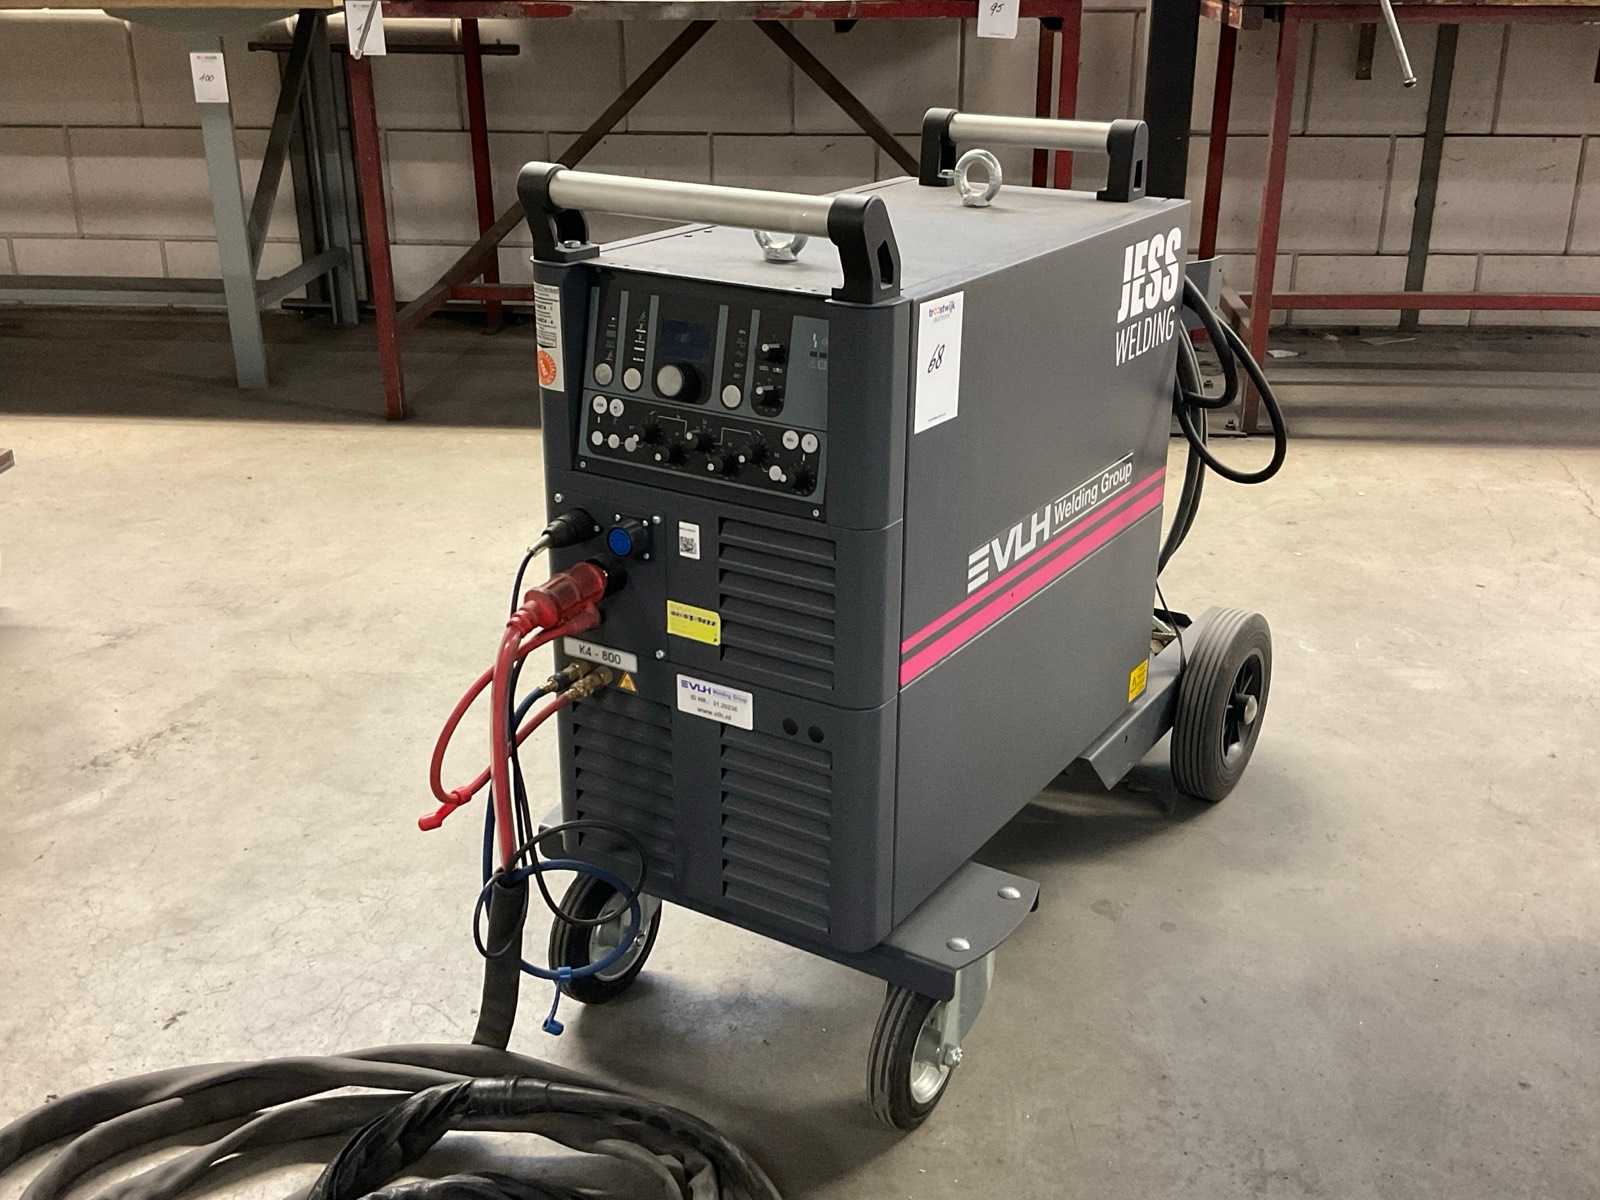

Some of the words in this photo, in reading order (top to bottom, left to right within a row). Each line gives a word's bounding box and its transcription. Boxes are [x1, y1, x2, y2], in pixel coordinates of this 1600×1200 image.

[991, 2, 1005, 16] 95
[1117, 227, 1182, 324] JESS
[927, 344, 945, 374] 68
[1115, 305, 1176, 367] WELDING
[1054, 484, 1099, 525] Welding
[1100, 461, 1133, 494] Group
[601, 651, 621, 665] 800
